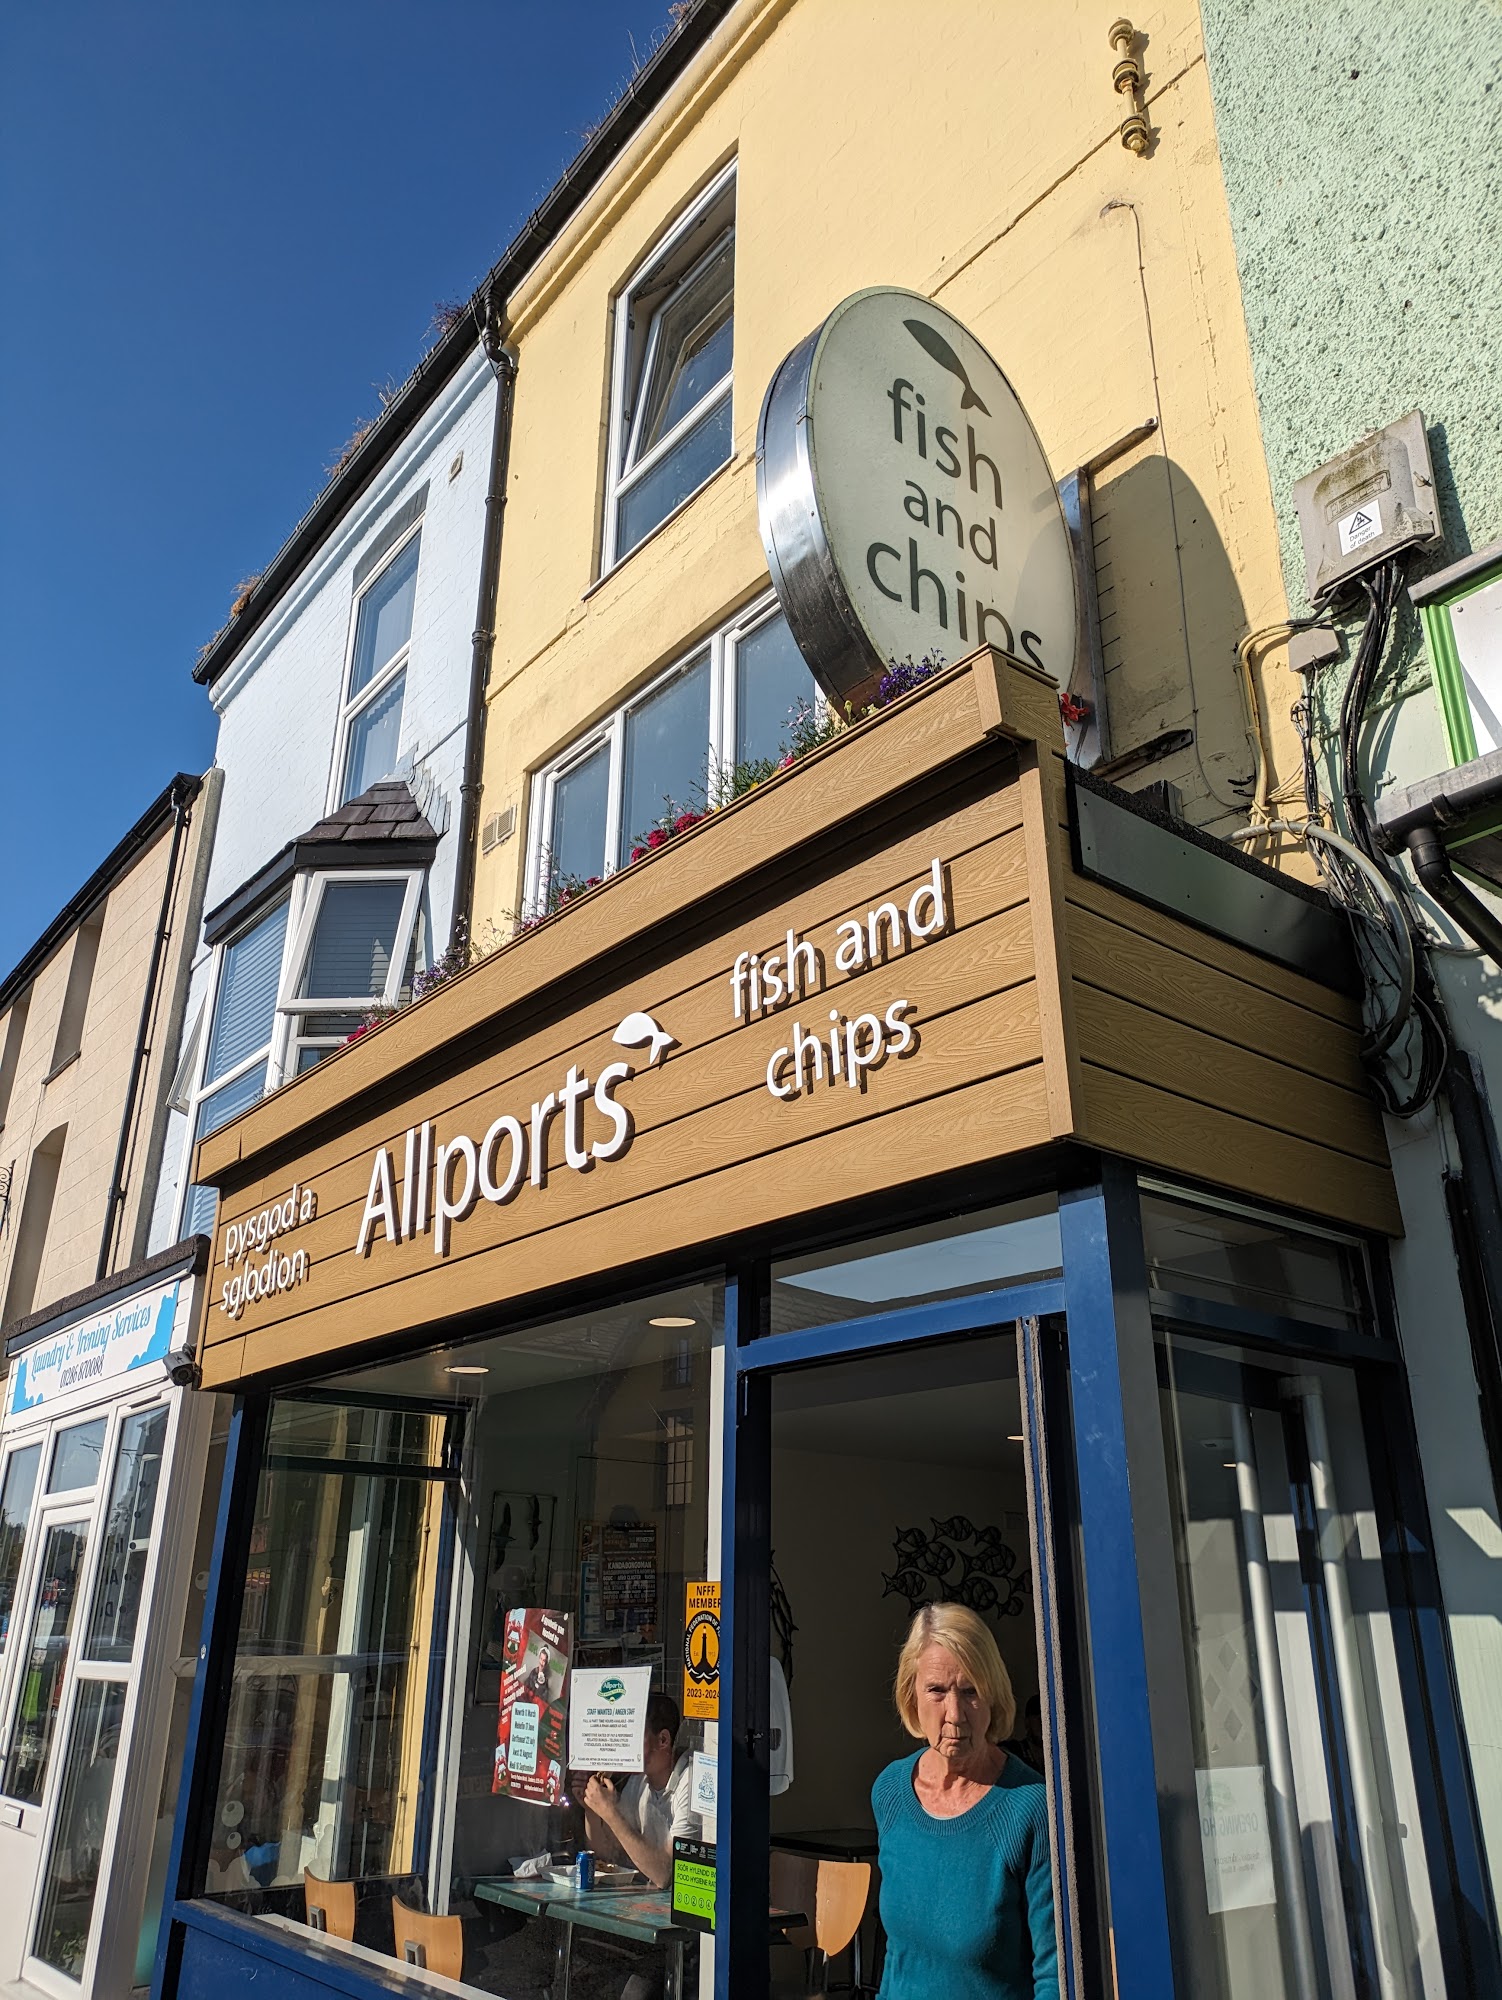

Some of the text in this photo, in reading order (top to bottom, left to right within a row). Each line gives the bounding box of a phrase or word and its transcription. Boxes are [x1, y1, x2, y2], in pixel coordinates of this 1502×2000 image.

[886, 378, 1003, 510] fish
[903, 480, 998, 571] and
[1349, 526, 1372, 542] Danger
[1350, 531, 1376, 549] of death
[867, 537, 1045, 670] chips
[730, 857, 945, 1018] fish and
[766, 999, 912, 1097] chips
[225, 1183, 312, 1267] pysgod a
[220, 1248, 305, 1318] sglodion
[31, 1304, 152, 1382] Laundry & Ironing Services
[697, 1586, 715, 1596] NFFF
[684, 1613, 719, 1668] NATIONAL FEDERATION OF
[677, 1873, 689, 1881] FOOD
[690, 1877, 708, 1886] HYGIENE
